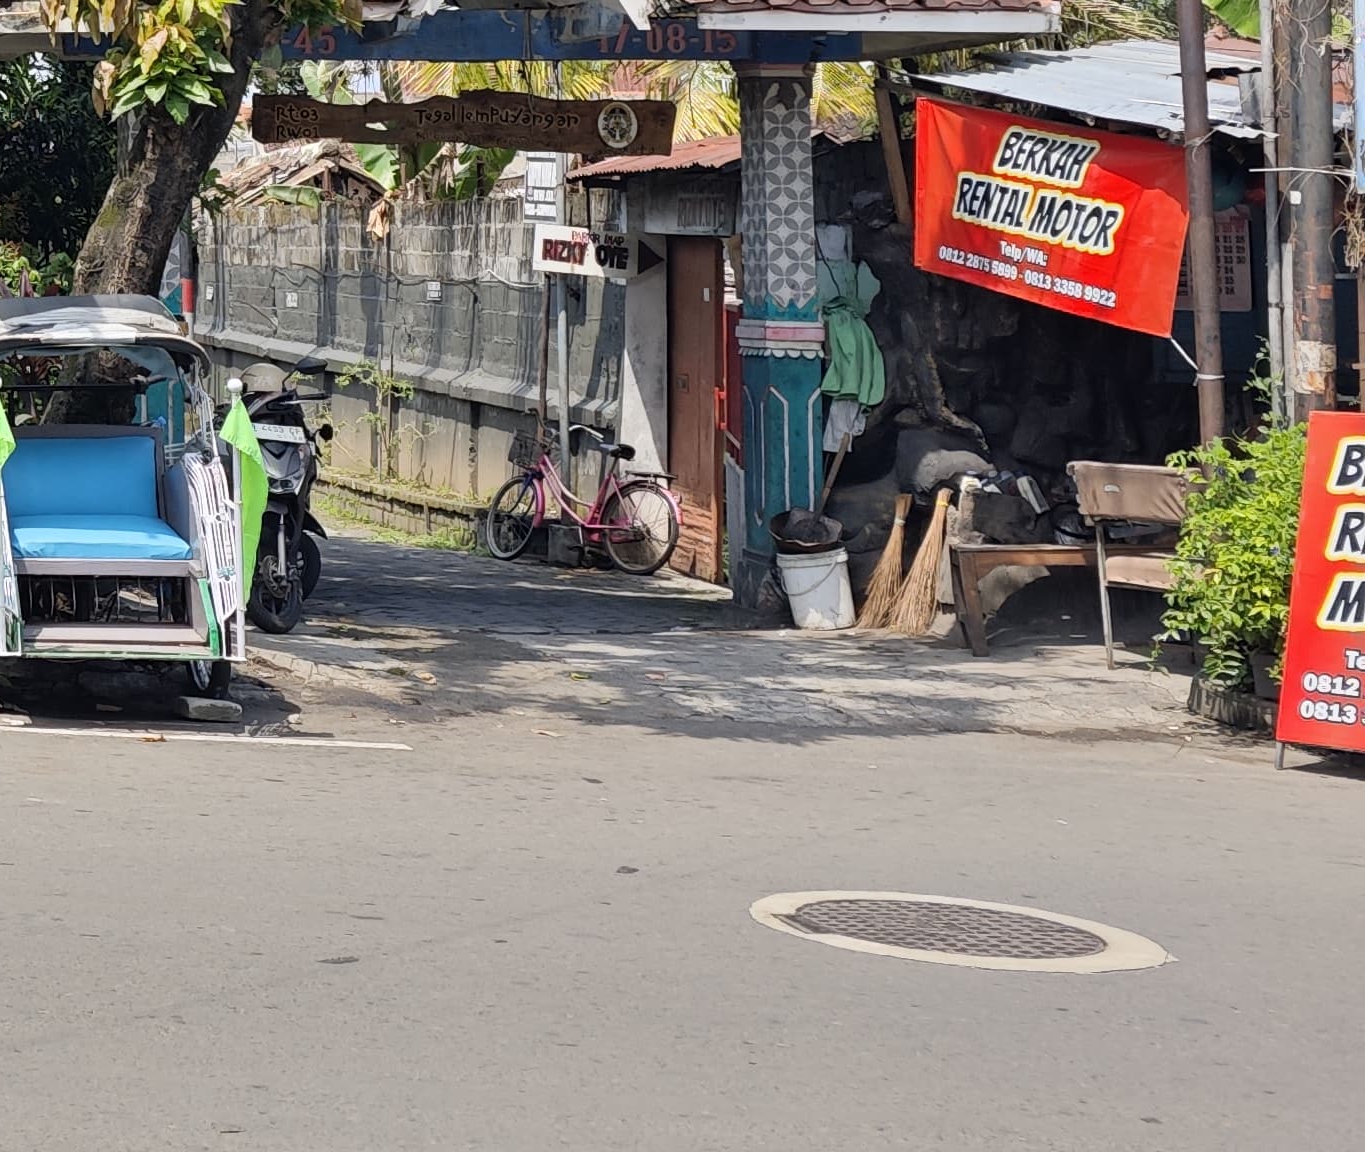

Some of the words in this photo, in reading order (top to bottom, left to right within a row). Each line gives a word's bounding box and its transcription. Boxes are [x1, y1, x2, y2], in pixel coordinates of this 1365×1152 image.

[1000, 131, 1097, 182] BERKAH
[955, 177, 1026, 228] RENTAL
[1031, 192, 1120, 250] MOTOR
[1335, 443, 1365, 487] B
[1334, 511, 1365, 554] R
[1302, 672, 1361, 698] 0812
[1299, 699, 1358, 726] 0813
